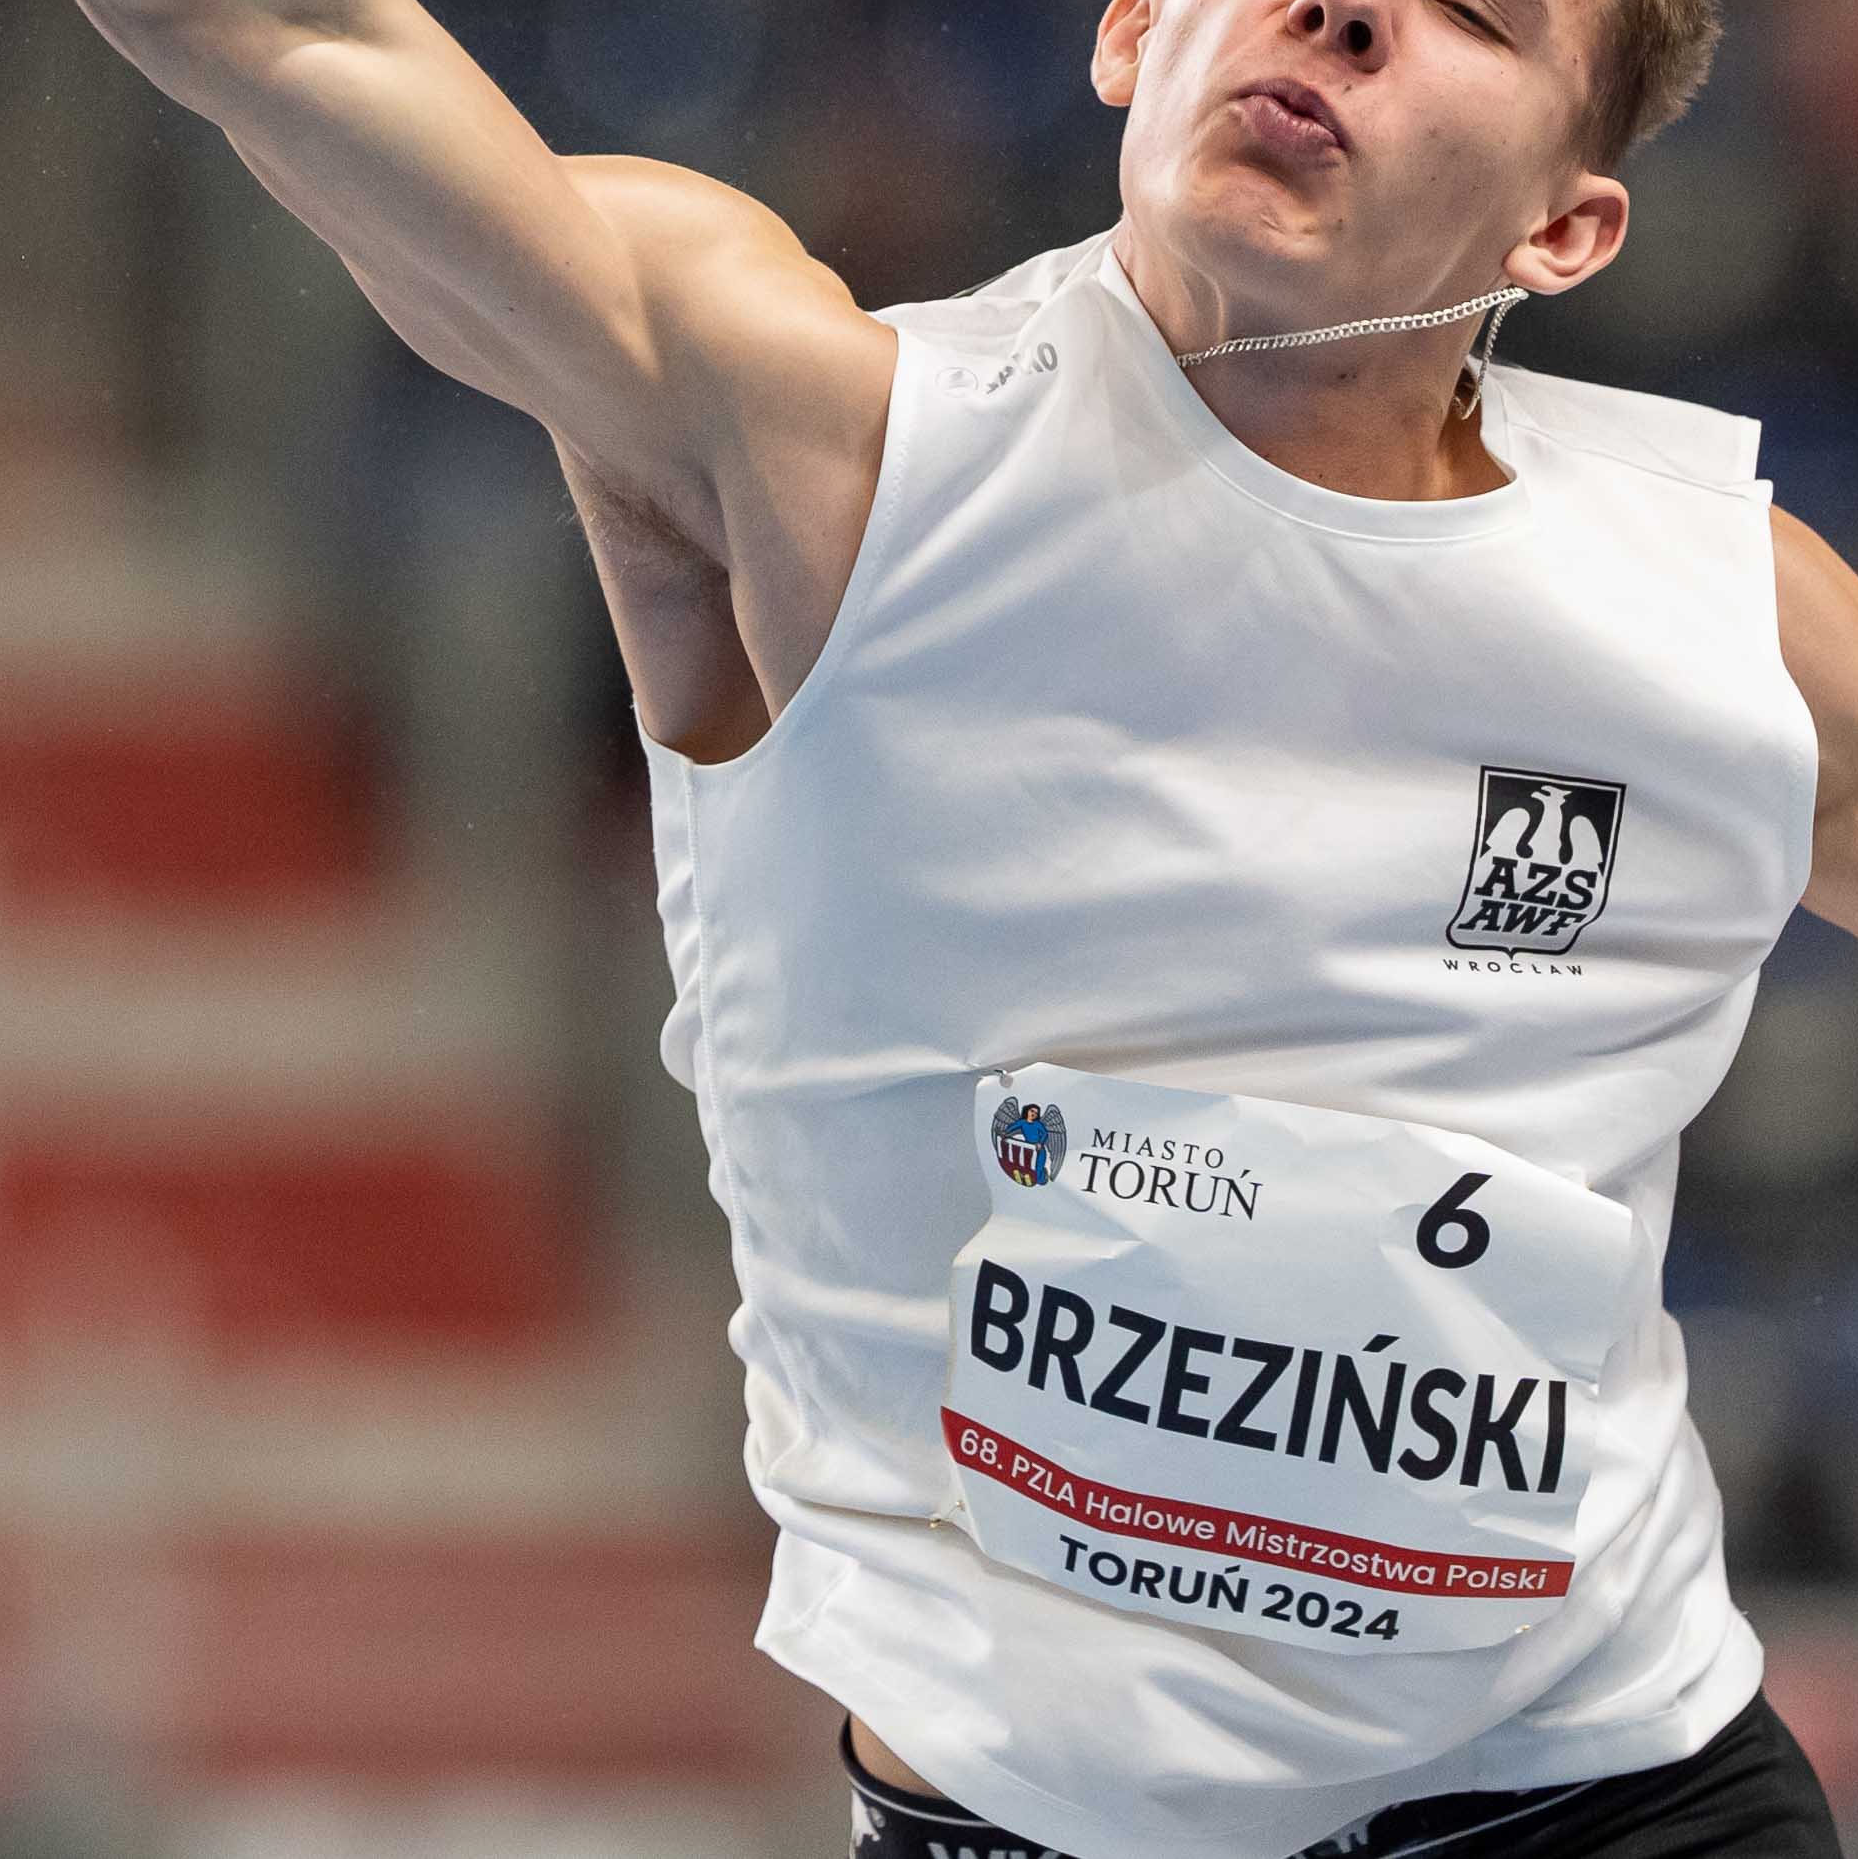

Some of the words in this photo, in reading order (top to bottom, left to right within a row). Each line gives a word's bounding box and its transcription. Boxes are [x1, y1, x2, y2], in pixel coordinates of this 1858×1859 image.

[1457, 899, 1587, 936] AWF
[1474, 855, 1598, 911] AZS
[1079, 1152, 1264, 1221] TORUŃ
[1091, 1128, 1224, 1169] MIASTO
[1415, 1172, 1493, 1269] 6
[970, 1258, 1568, 1495] BRZEZIŃSKI
[959, 1427, 1004, 1471] 68.
[1011, 1453, 1076, 1509] PZLA
[1084, 1491, 1216, 1540] Halowe
[1225, 1520, 1437, 1586] Mistrzostwa
[1445, 1564, 1549, 1591] Polski
[1059, 1533, 1250, 1614] TORUŃ
[1261, 1583, 1401, 1641] 2024
